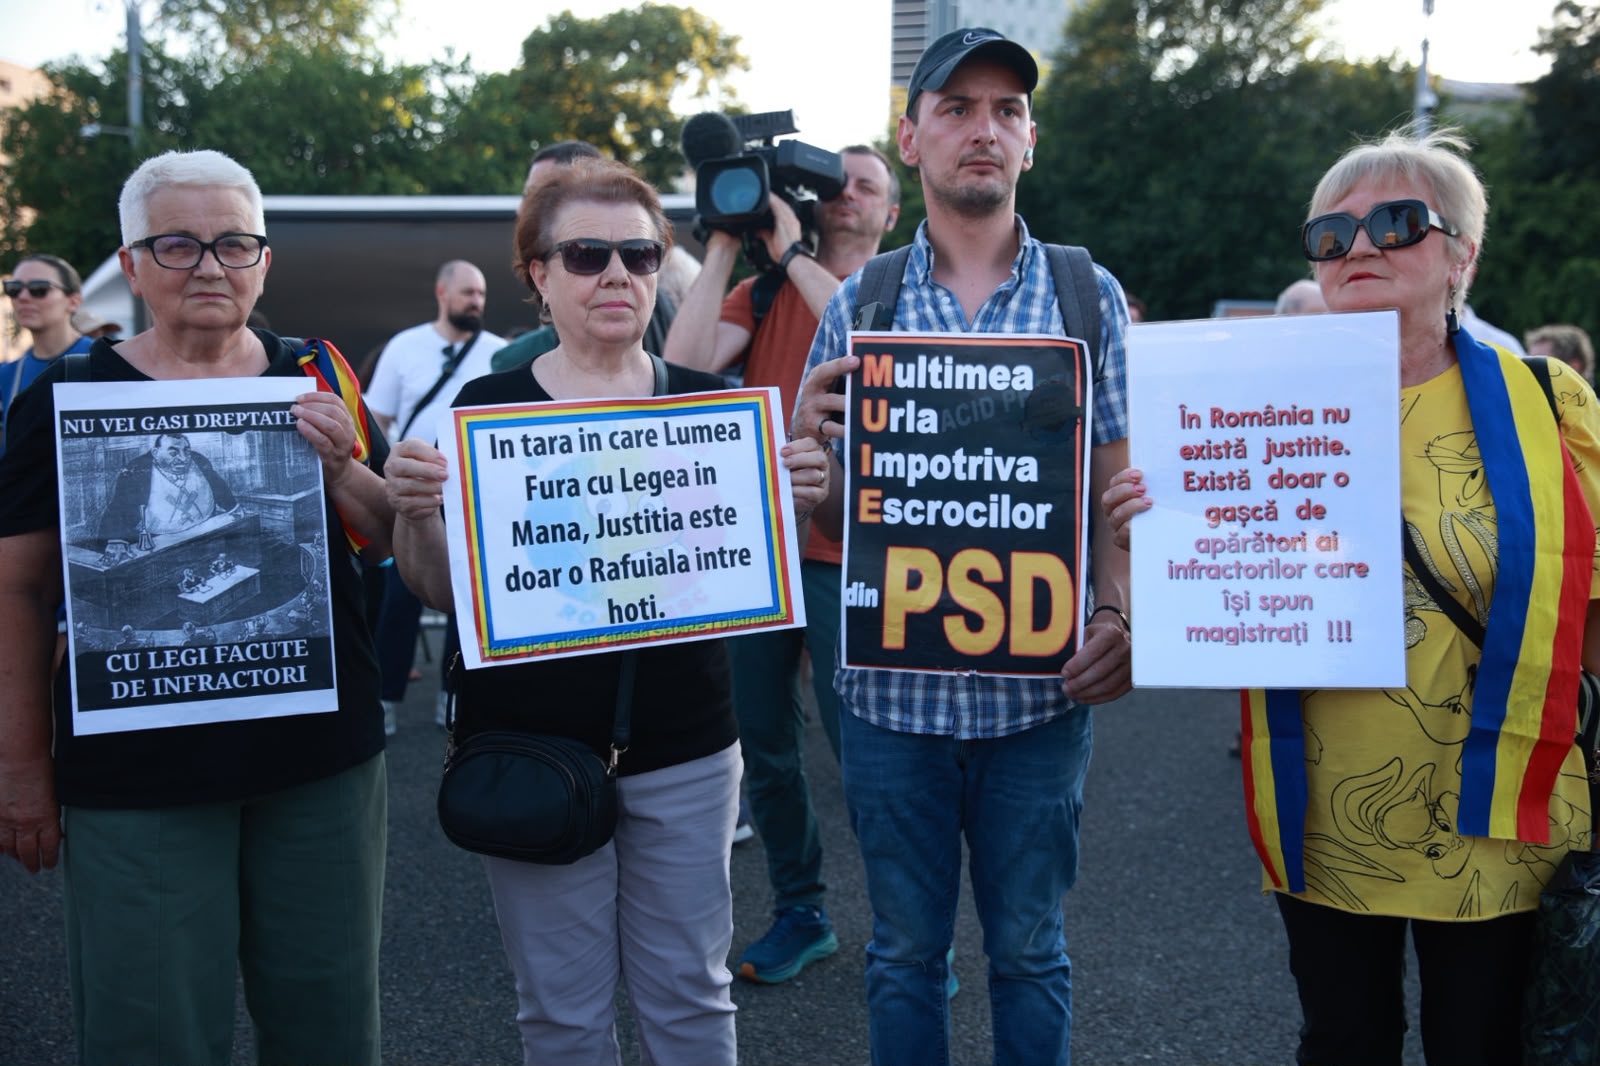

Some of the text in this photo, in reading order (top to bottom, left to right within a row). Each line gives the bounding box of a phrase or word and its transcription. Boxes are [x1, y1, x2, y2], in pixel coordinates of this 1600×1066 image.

[863, 354, 1034, 391] Multimea
[64, 410, 297, 434] NU VEI GASI DREPTATE
[862, 399, 938, 433] Urla
[1179, 404, 1350, 429] În România nu
[489, 421, 741, 460] In tara in care Lumea
[1180, 434, 1351, 464] există justitie.
[525, 460, 717, 501] Fura cu Legea in
[860, 444, 1038, 487] Impotriva
[1183, 467, 1349, 491] Există doar o
[858, 489, 1052, 529] Escrocilor
[1205, 498, 1327, 528] gașcă de
[511, 506, 737, 547] Mana, Justitia este
[1195, 531, 1338, 559] apărători ai
[505, 546, 751, 592] doar o Rafuiala intre
[1168, 557, 1369, 580] infractorilor care
[607, 594, 666, 624] hoti.
[846, 545, 1074, 657] din PSD
[1222, 589, 1313, 618] își spun
[1186, 620, 1352, 646] magistrați !!!
[106, 639, 309, 673] CU LEGI FACUTE
[111, 665, 307, 700] DE INFRACTORI
